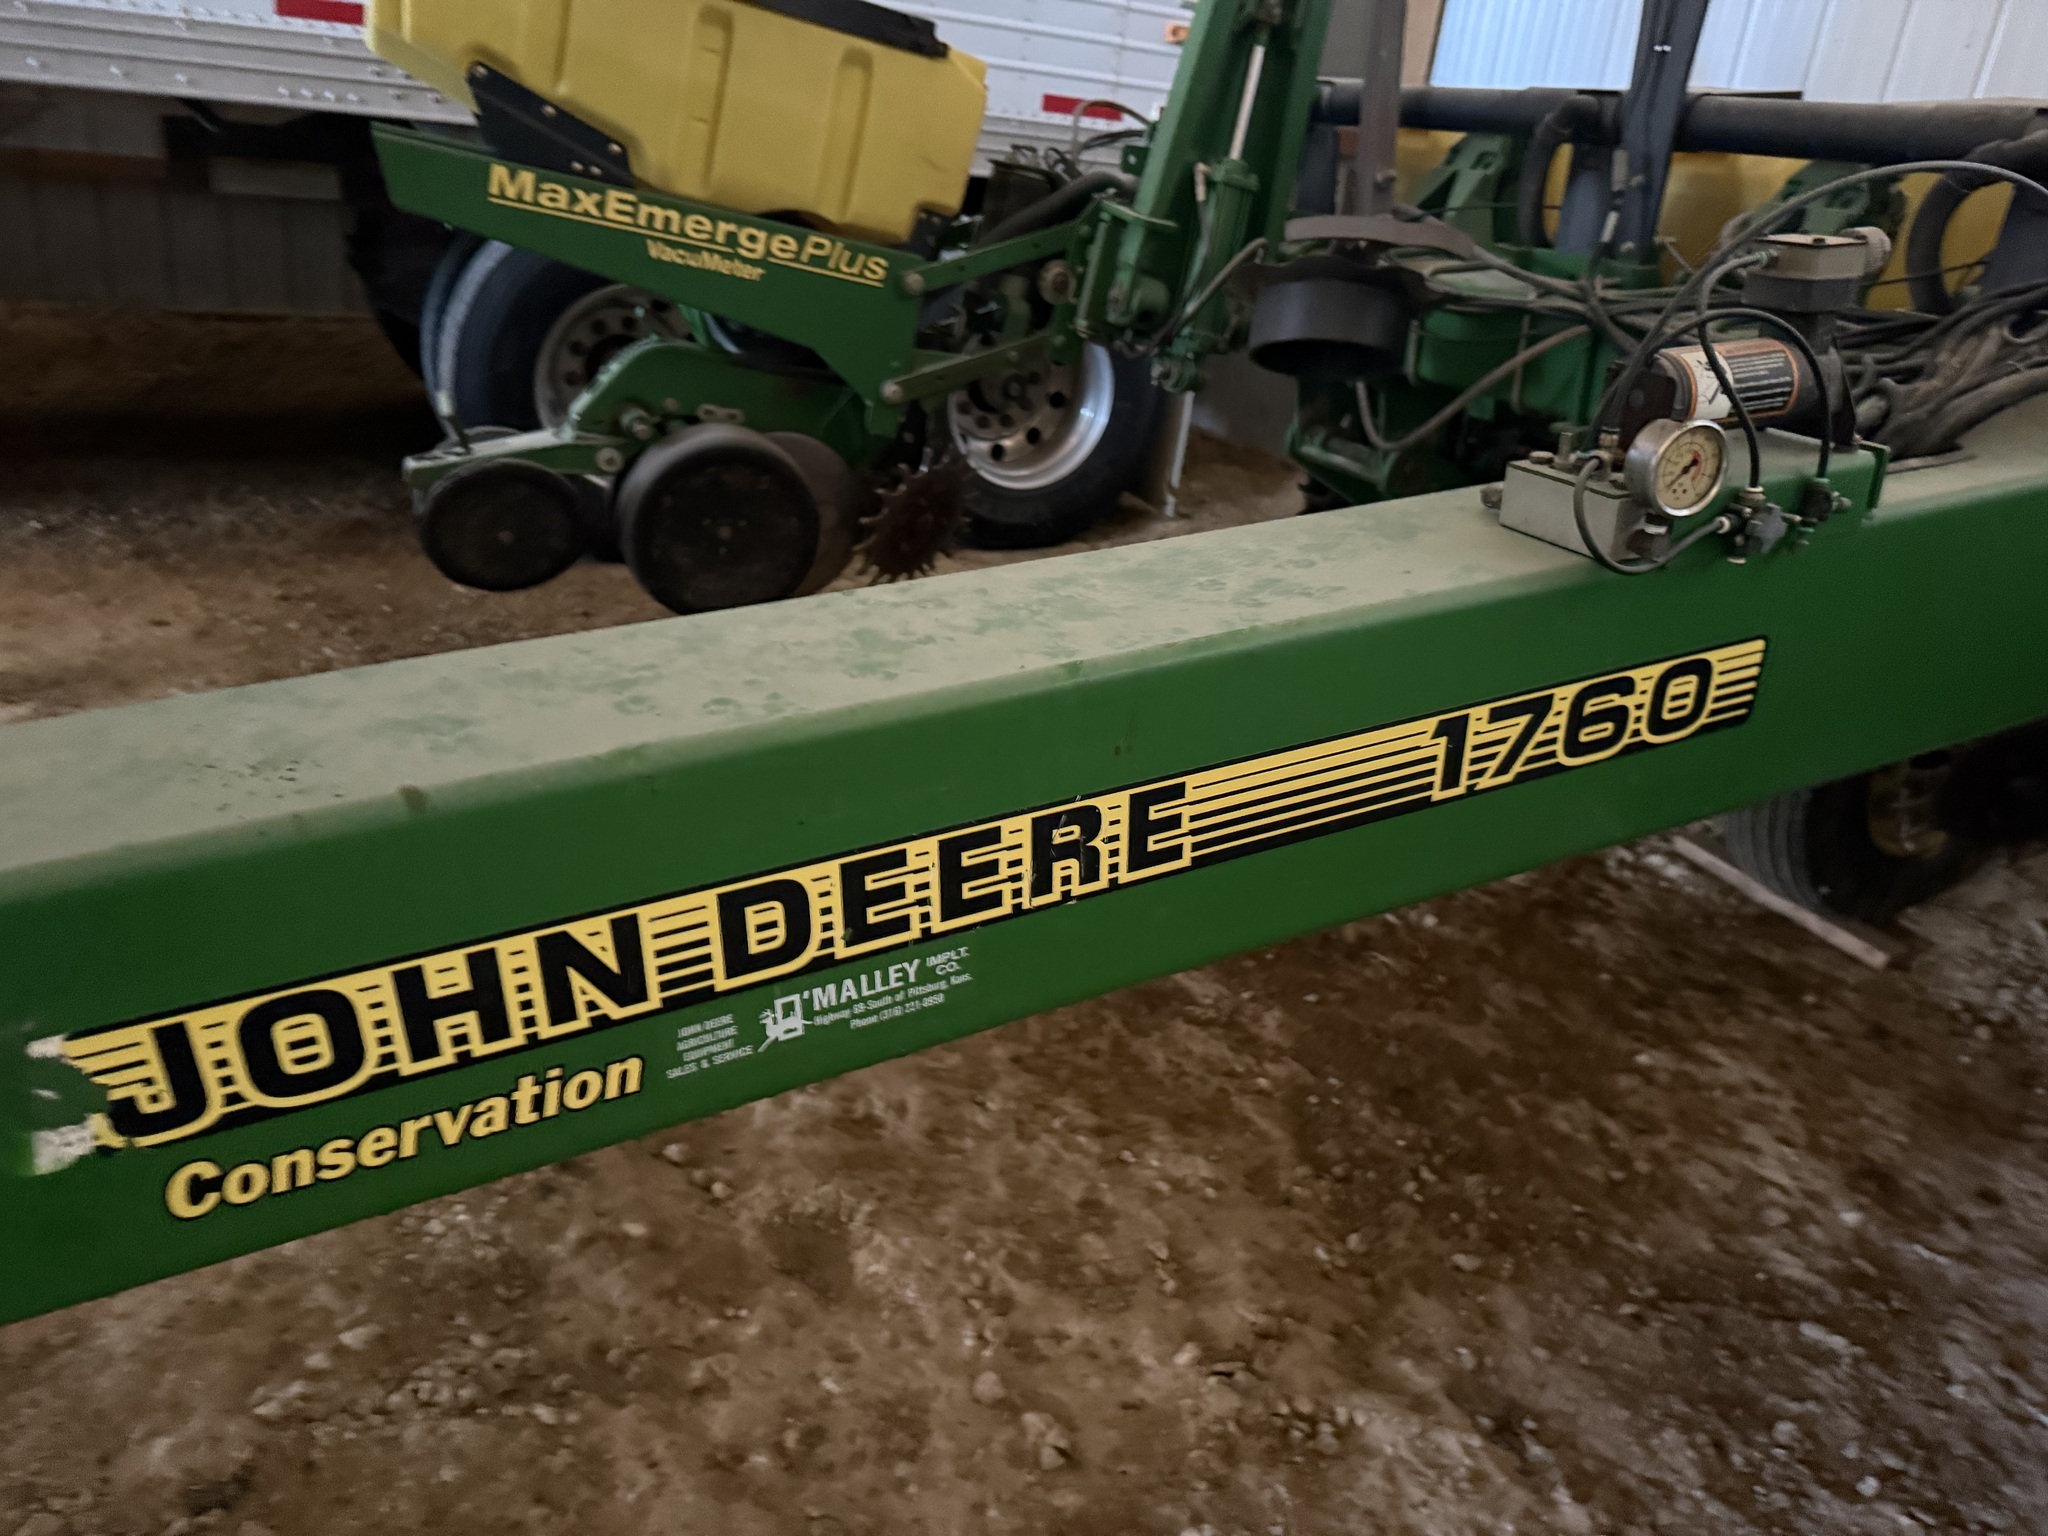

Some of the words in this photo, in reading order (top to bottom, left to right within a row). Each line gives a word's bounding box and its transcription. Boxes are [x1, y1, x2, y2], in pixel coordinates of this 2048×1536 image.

[106, 908, 655, 1142] JOHN
[712, 779, 1190, 986] DEERE
[1430, 657, 1713, 795] 1760
[164, 1053, 645, 1221] Conservation
